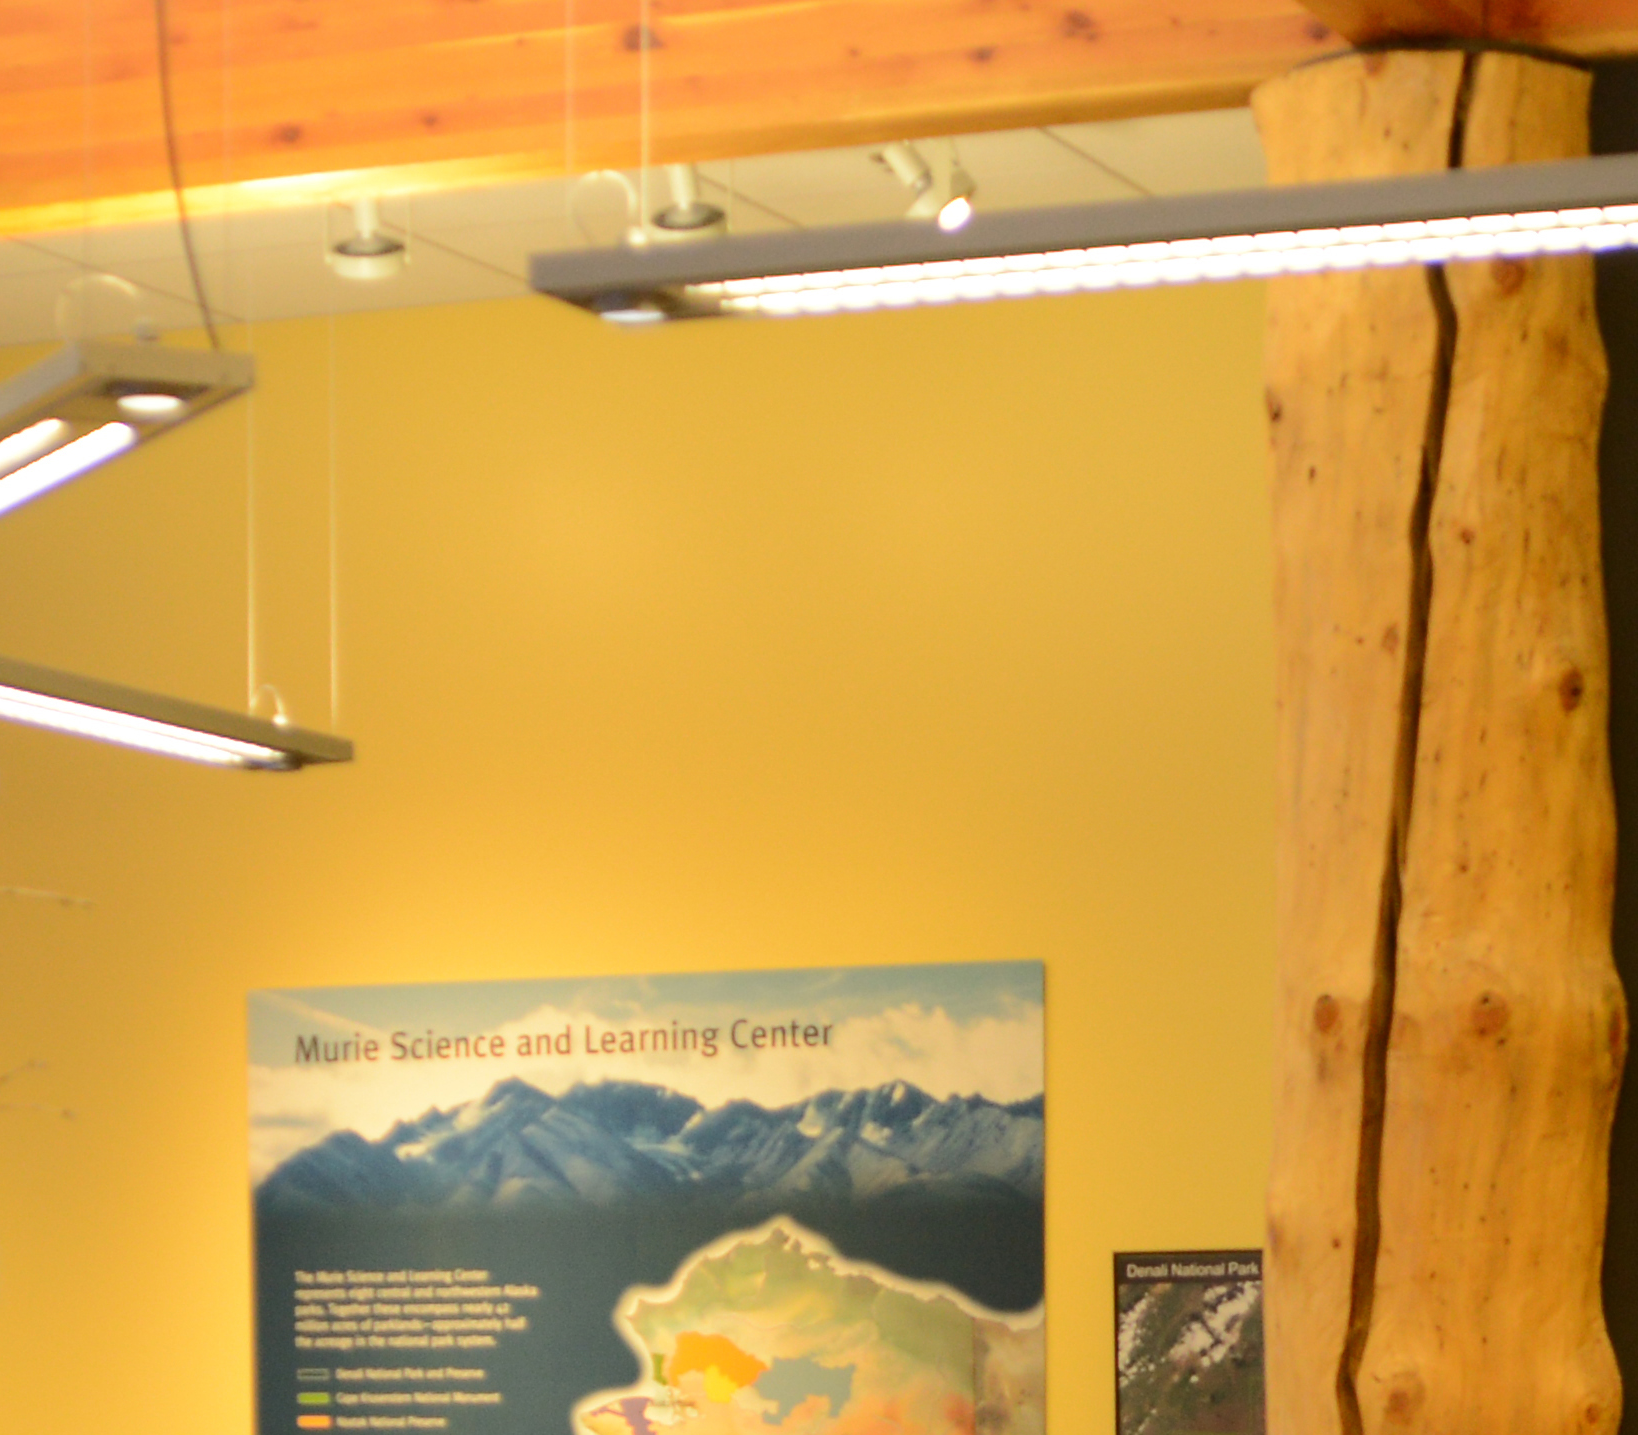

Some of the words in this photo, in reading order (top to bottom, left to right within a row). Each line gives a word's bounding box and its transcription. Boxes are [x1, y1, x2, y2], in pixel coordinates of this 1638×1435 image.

[295, 1032, 380, 1063] Murie
[390, 1030, 505, 1061] Science
[517, 1024, 572, 1056] and
[585, 1020, 719, 1057] Learning
[731, 1018, 833, 1049] Center
[1126, 1263, 1168, 1278] Denali
[1171, 1263, 1225, 1276] National
[1228, 1261, 1260, 1275] Park
